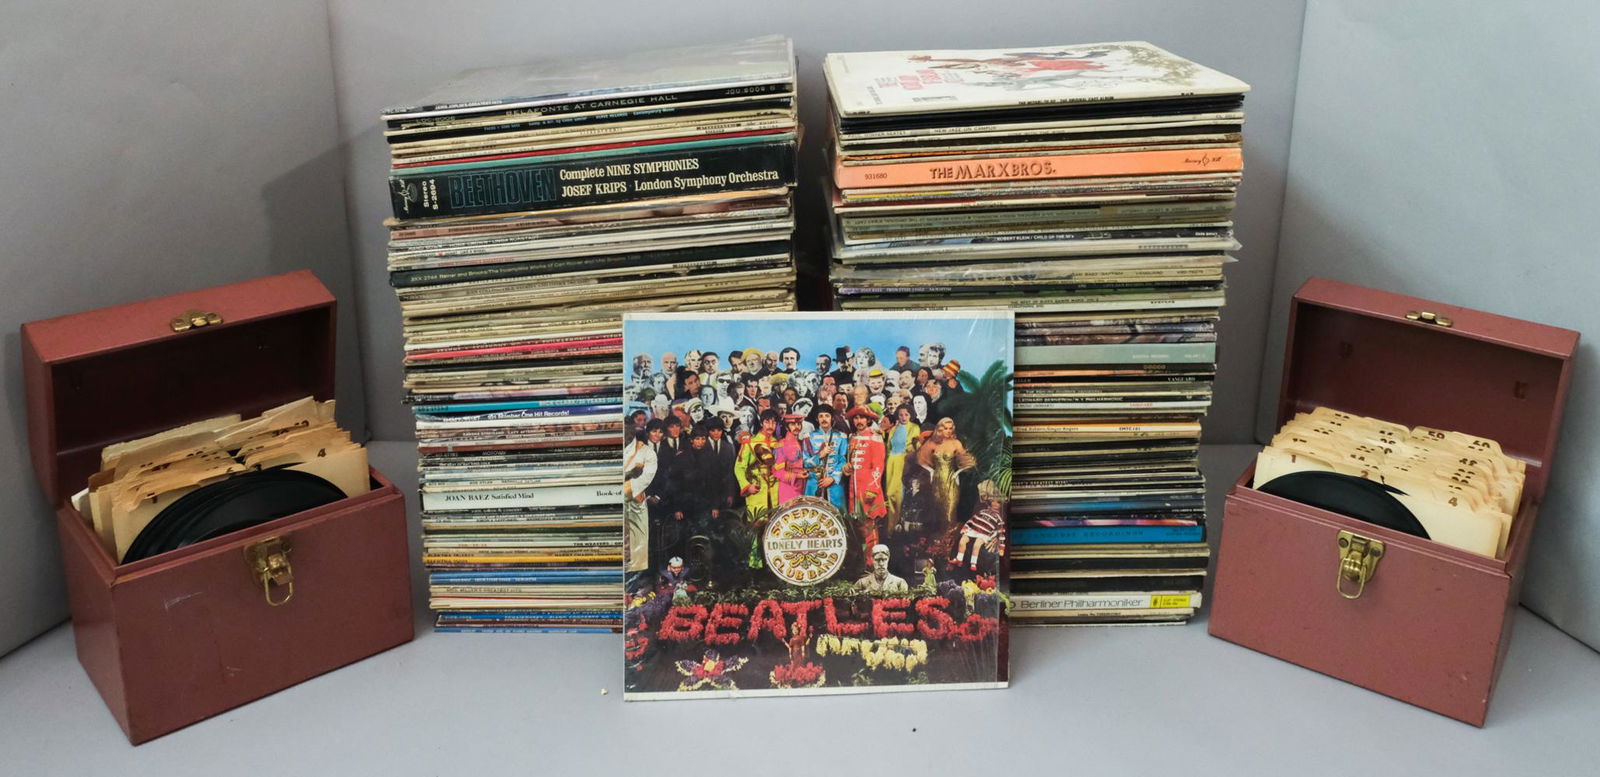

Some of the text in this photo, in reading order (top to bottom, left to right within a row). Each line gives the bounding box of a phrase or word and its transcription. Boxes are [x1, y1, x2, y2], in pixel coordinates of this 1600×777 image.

[590, 97, 646, 108] CARNEGIE
[560, 158, 700, 182] Complete NINE SYMPHONIES
[864, 172, 888, 180] 931680
[930, 167, 953, 180] THE
[450, 168, 557, 209] BEETHOVEN
[561, 170, 780, 198] JOSEF KRIPS London Symphony Orchestra
[422, 180, 430, 208] Stereo
[429, 178, 439, 210] S-2694
[317, 448, 327, 458] 4
[445, 492, 534, 502] JOAN BAEZ Satisfied Mind
[1448, 496, 1458, 507] 4
[767, 538, 844, 551] LONELY HEARTS
[772, 552, 839, 580] CLUB BAND
[1020, 598, 1143, 609] Berliner Philharmoniker
[656, 596, 953, 646] BEATLES
